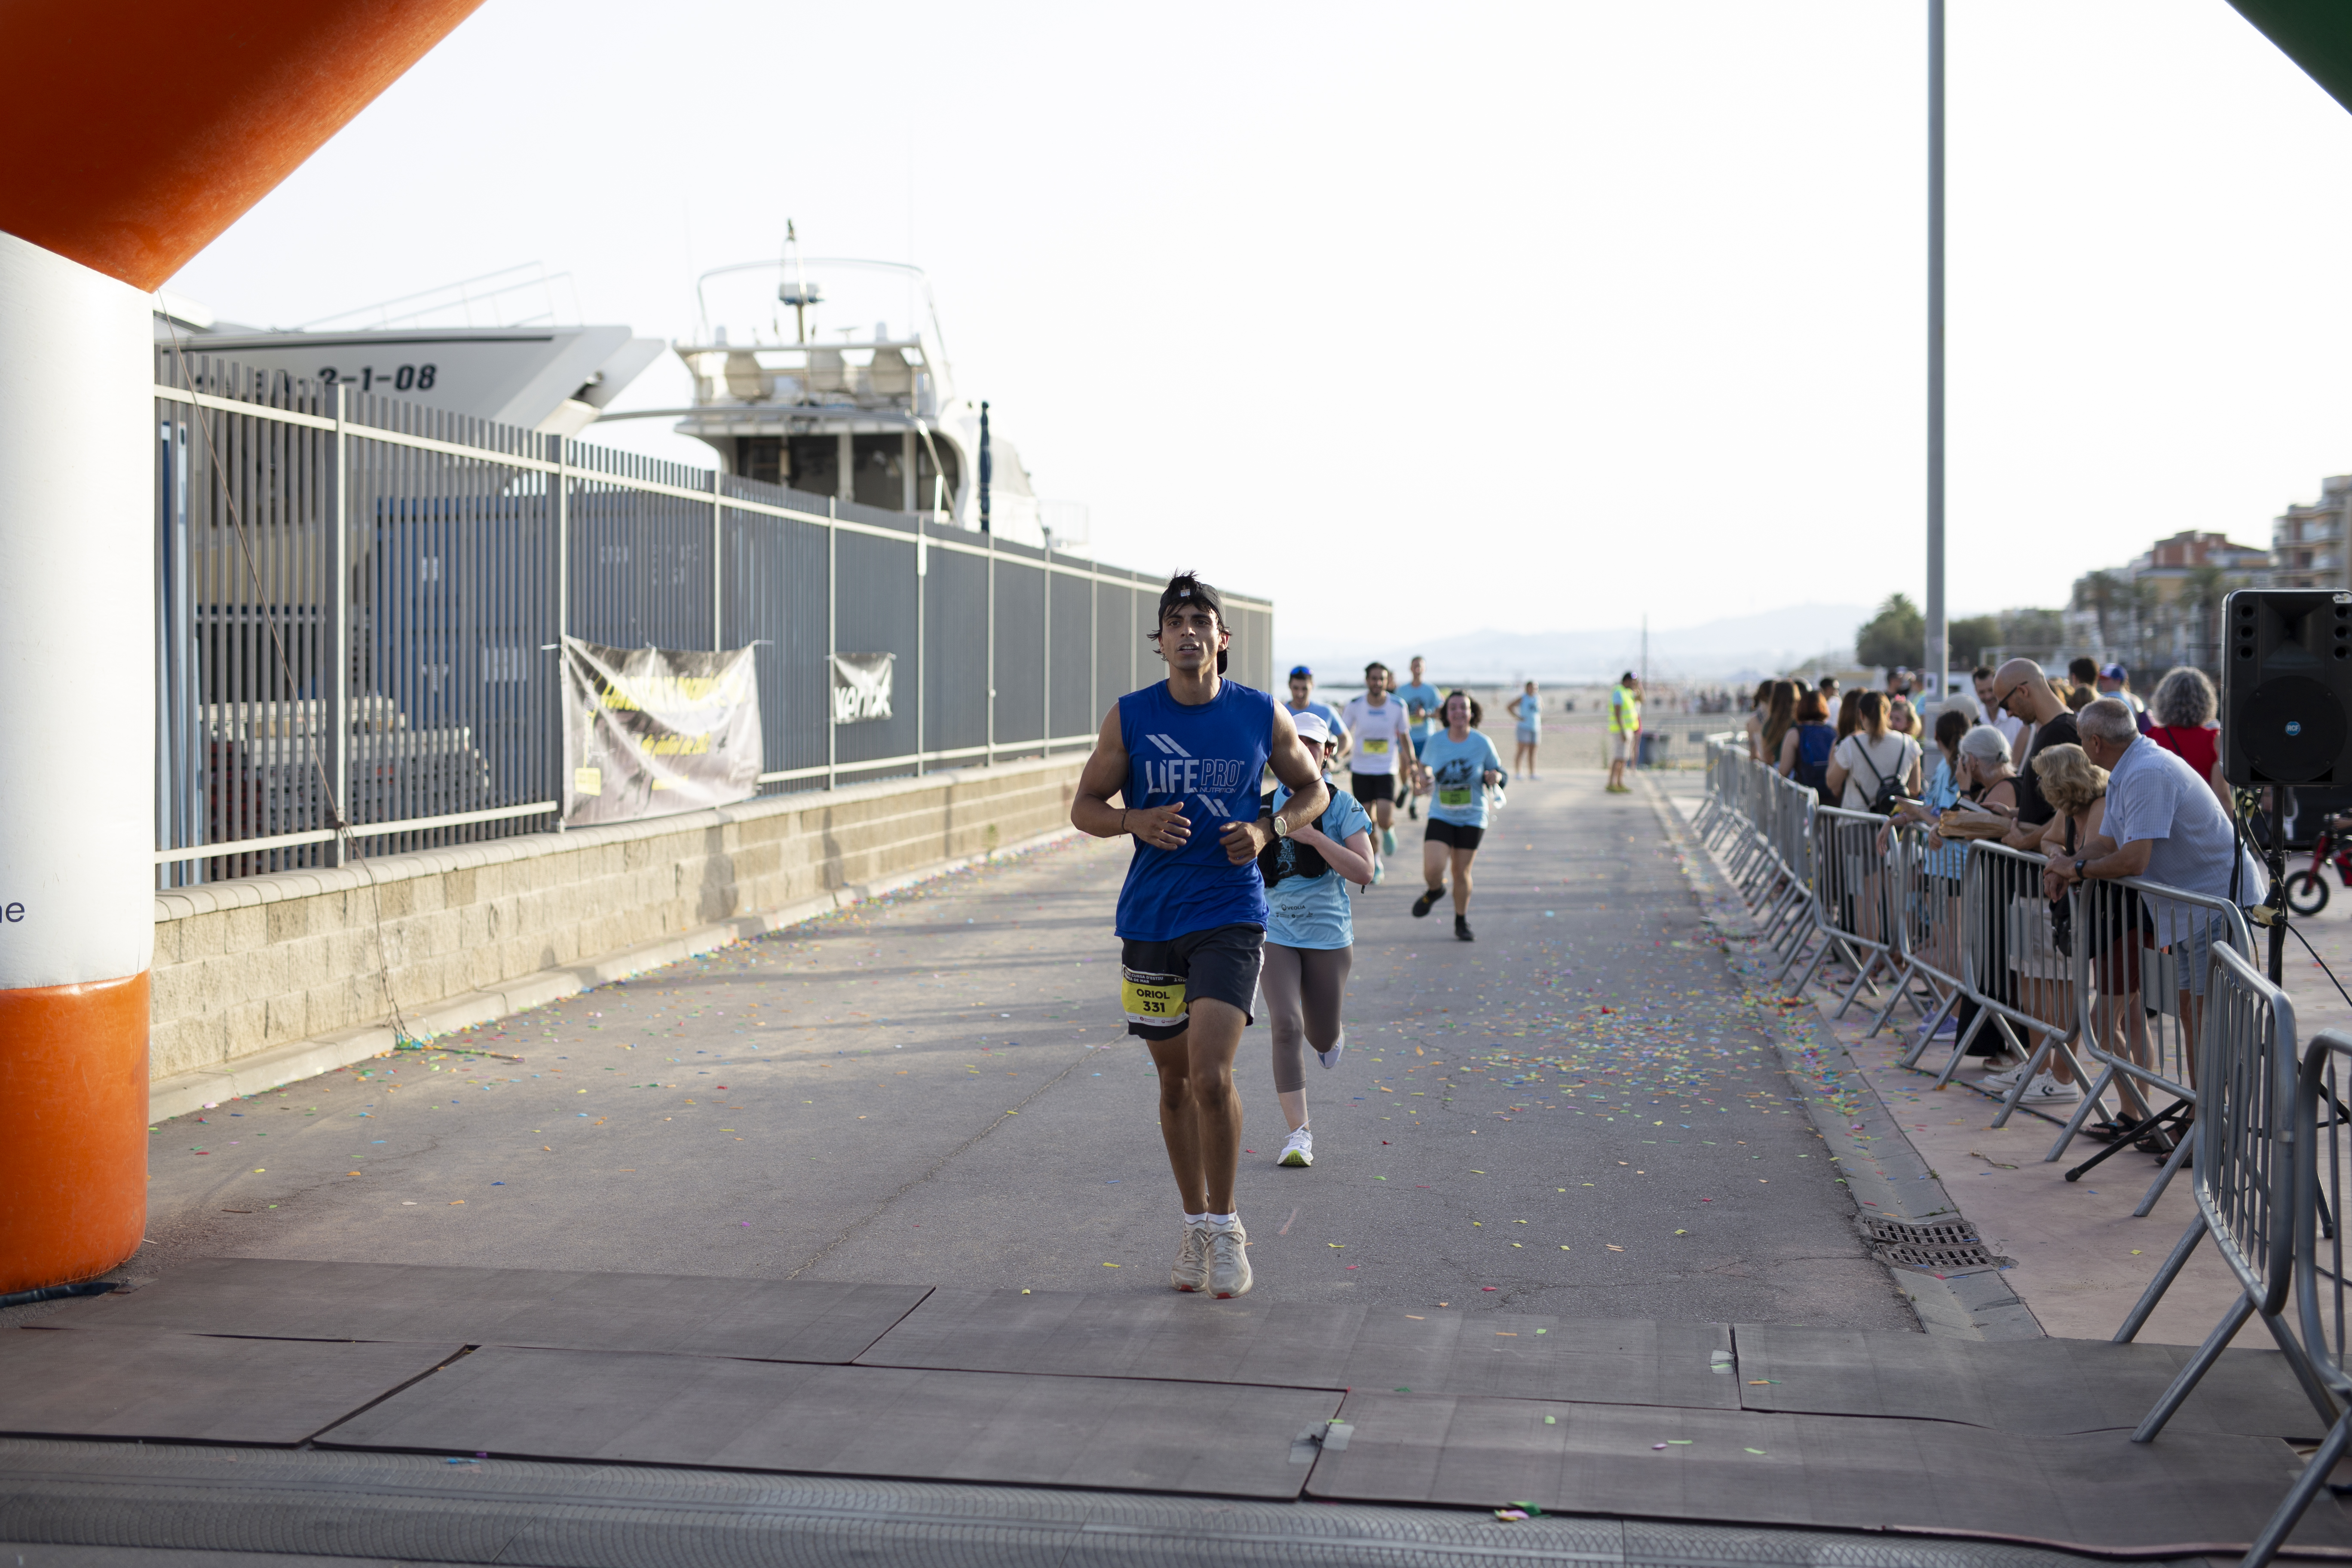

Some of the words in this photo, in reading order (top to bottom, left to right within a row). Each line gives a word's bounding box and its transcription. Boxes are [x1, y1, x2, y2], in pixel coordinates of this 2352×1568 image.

[1145, 759, 1200, 794] LIFE
[1201, 759, 1240, 787] PRO
[0, 902, 25, 923] e
[1136, 988, 1170, 999] ORIOL
[1142, 1000, 1165, 1013] 331
